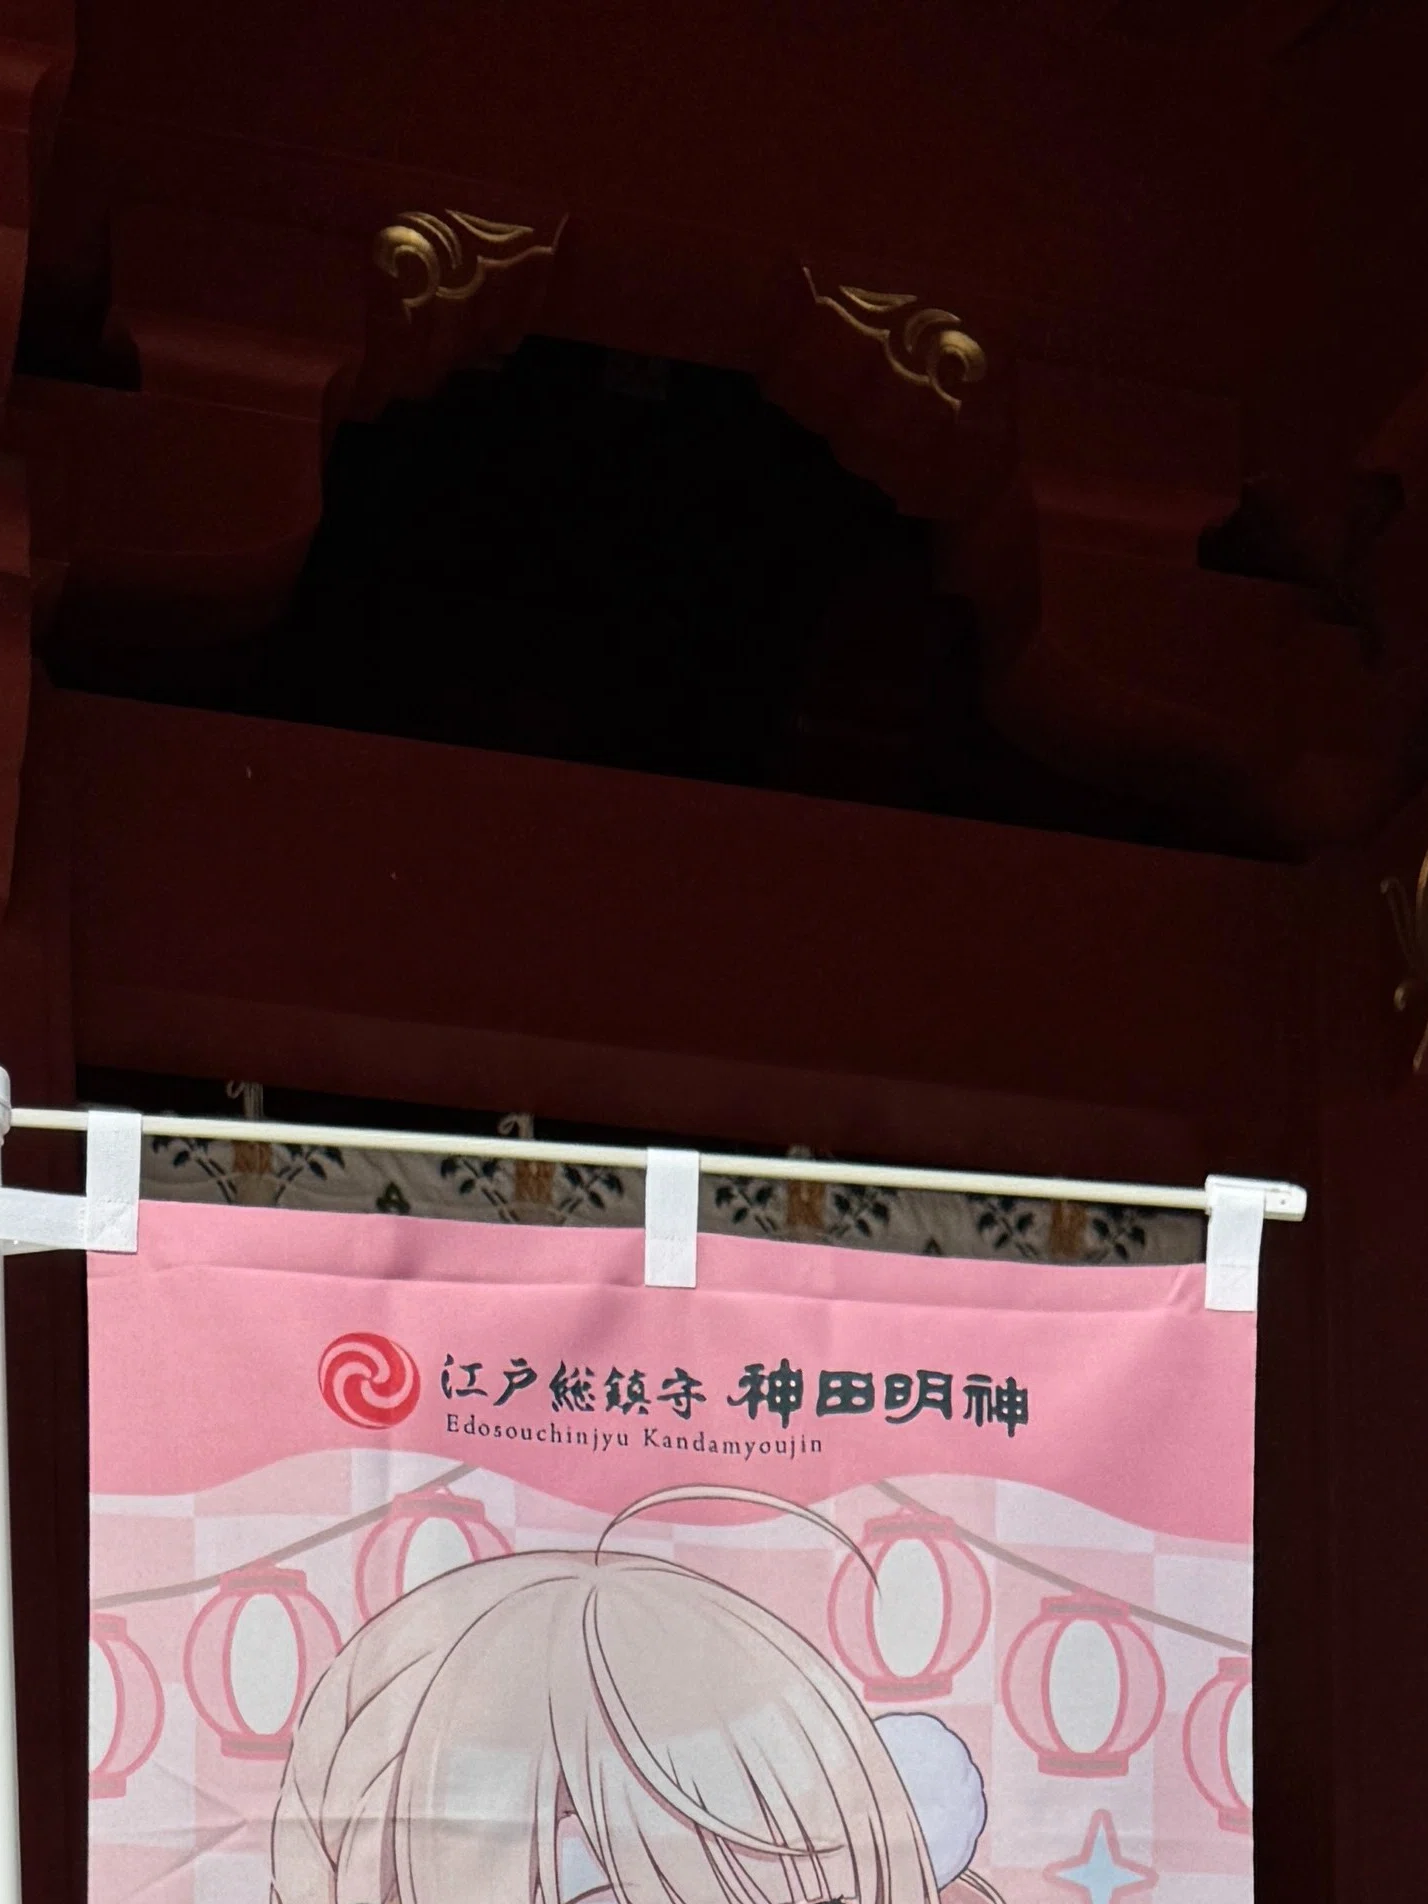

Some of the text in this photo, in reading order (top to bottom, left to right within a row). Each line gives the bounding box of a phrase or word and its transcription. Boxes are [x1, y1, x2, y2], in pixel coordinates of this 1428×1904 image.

[440, 1353, 1029, 1438] 江戸総鎮守 神田明神
[445, 1413, 823, 1461] Edosouchinjyu Kandamyoujin
